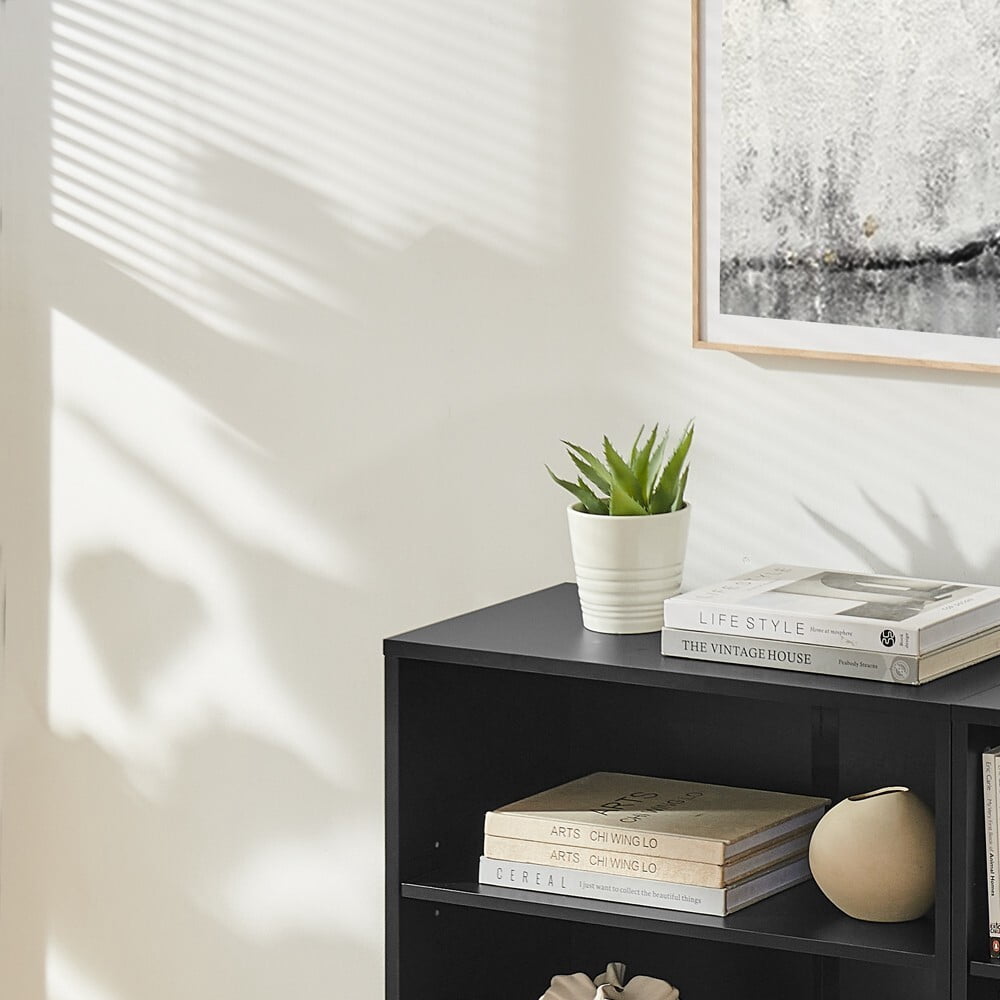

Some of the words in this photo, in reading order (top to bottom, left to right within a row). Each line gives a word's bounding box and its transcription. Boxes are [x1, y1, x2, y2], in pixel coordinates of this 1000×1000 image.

[681, 639, 707, 653] THE
[710, 643, 766, 659] VINTAGE
[767, 649, 812, 665] HOUSE
[589, 792, 659, 816] ARTS
[550, 825, 581, 839] ARTS
[589, 830, 609, 843] CHI
[611, 832, 641, 847] WING
[642, 837, 658, 849] LO
[550, 850, 580, 864] ARTS
[589, 854, 608, 867] CHI
[610, 857, 640, 871] WING
[641, 862, 657, 874] LO
[496, 867, 566, 889] CEREAL
[582, 881, 595, 890] just
[595, 883, 612, 892] want
[612, 885, 619, 893] to
[619, 886, 641, 896] collect
[641, 887, 652, 897] the
[652, 889, 681, 901] beautiful
[681, 894, 702, 904] things
